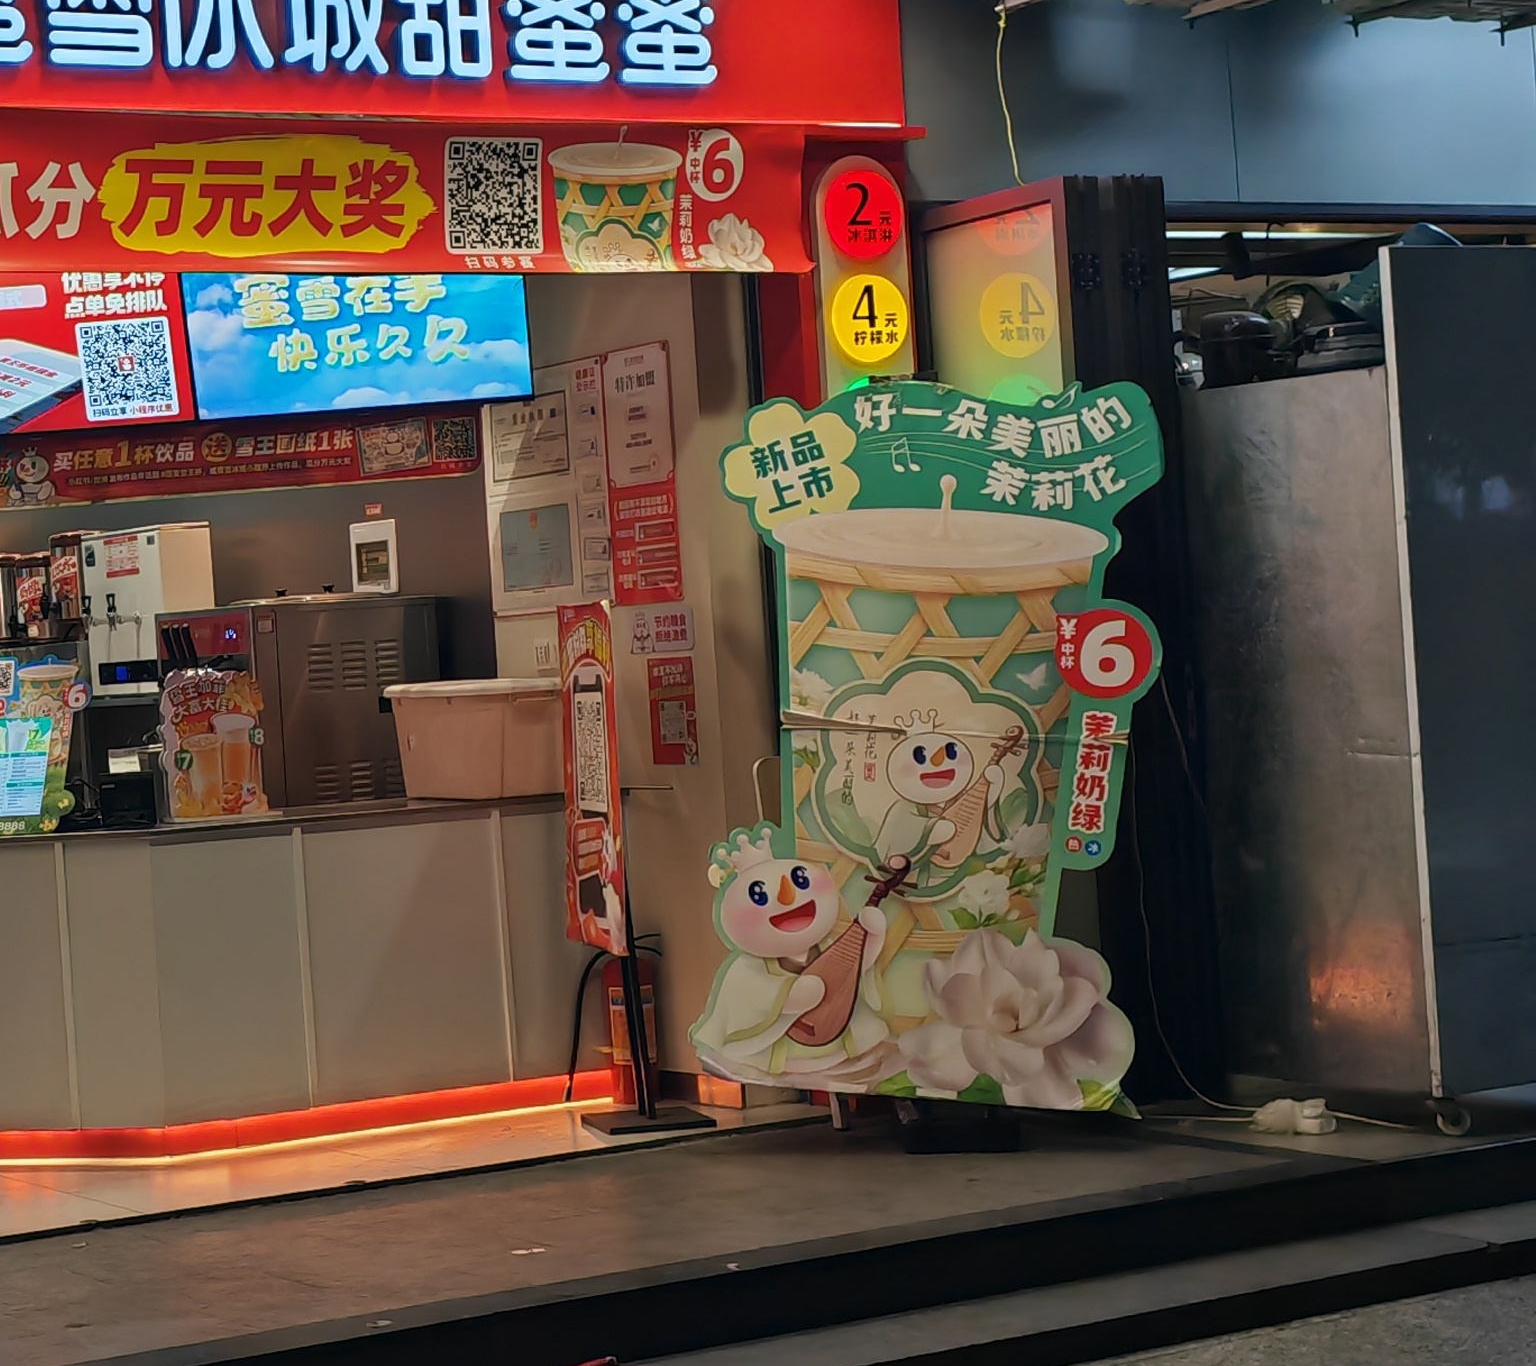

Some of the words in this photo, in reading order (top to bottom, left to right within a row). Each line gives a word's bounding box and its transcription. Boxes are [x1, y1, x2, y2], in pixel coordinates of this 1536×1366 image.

[848, 228, 893, 243] 冰淇淋
[65, 289, 167, 319] 点单免排队
[234, 275, 447, 329] 蜜雪在手
[269, 315, 469, 373] 快乐久久
[854, 330, 899, 346] 柠檬水
[854, 391, 1133, 459] 好一朵美丽的
[53, 440, 195, 473] 买任意1杯饮品
[750, 431, 826, 480] 新品
[768, 466, 835, 515] 上市
[979, 453, 1127, 512] 茉莉花
[1060, 642, 1076, 670] 中杯
[1069, 713, 1115, 832] 茉莉奶绿
